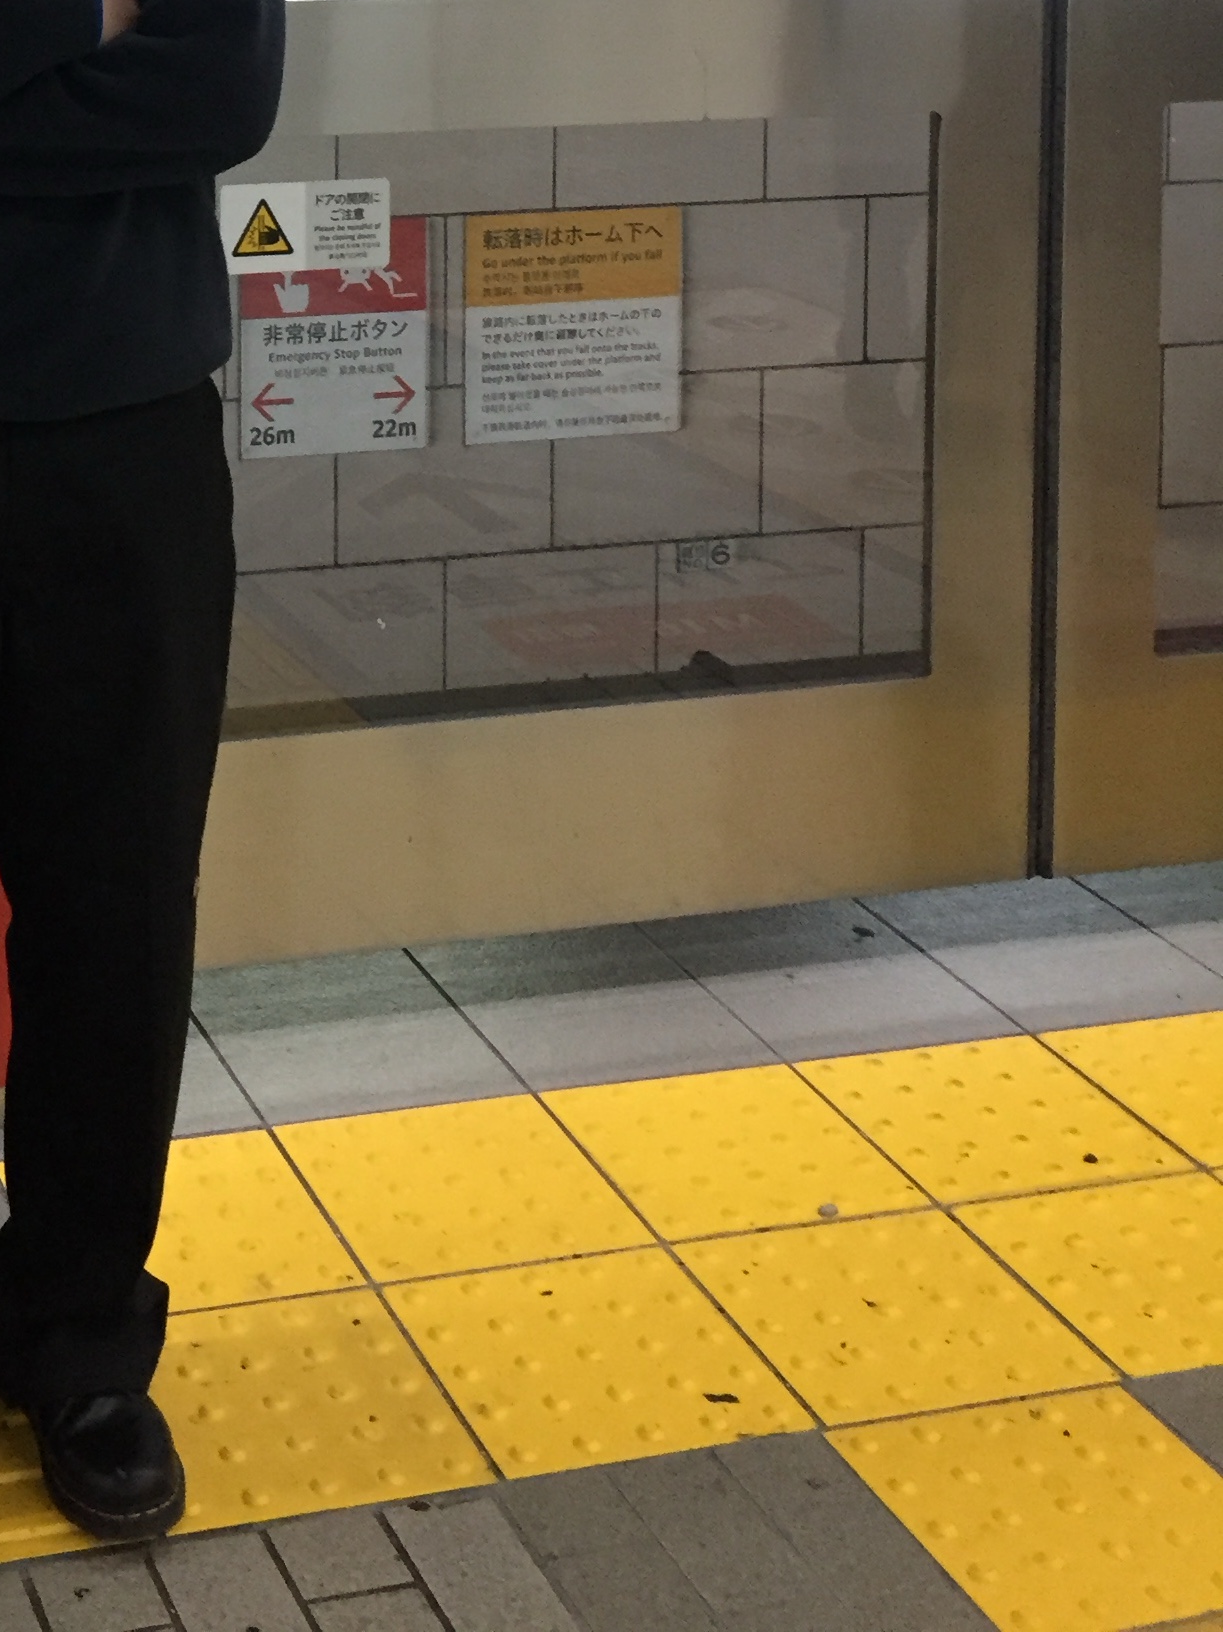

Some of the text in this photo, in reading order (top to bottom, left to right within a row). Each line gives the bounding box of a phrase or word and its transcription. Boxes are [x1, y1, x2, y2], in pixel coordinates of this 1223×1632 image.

[483, 222, 663, 250] 転落時はホーム下へ
[501, 257, 533, 268] under
[537, 255, 556, 265] the
[559, 252, 607, 265] platform
[611, 251, 620, 262] if
[622, 251, 642, 264] you
[645, 248, 663, 260] fall
[263, 320, 408, 346] 非常停止ボタン
[268, 347, 402, 364] Emergency Stop Button
[250, 426, 295, 446] 26m
[372, 419, 416, 438] 22m
